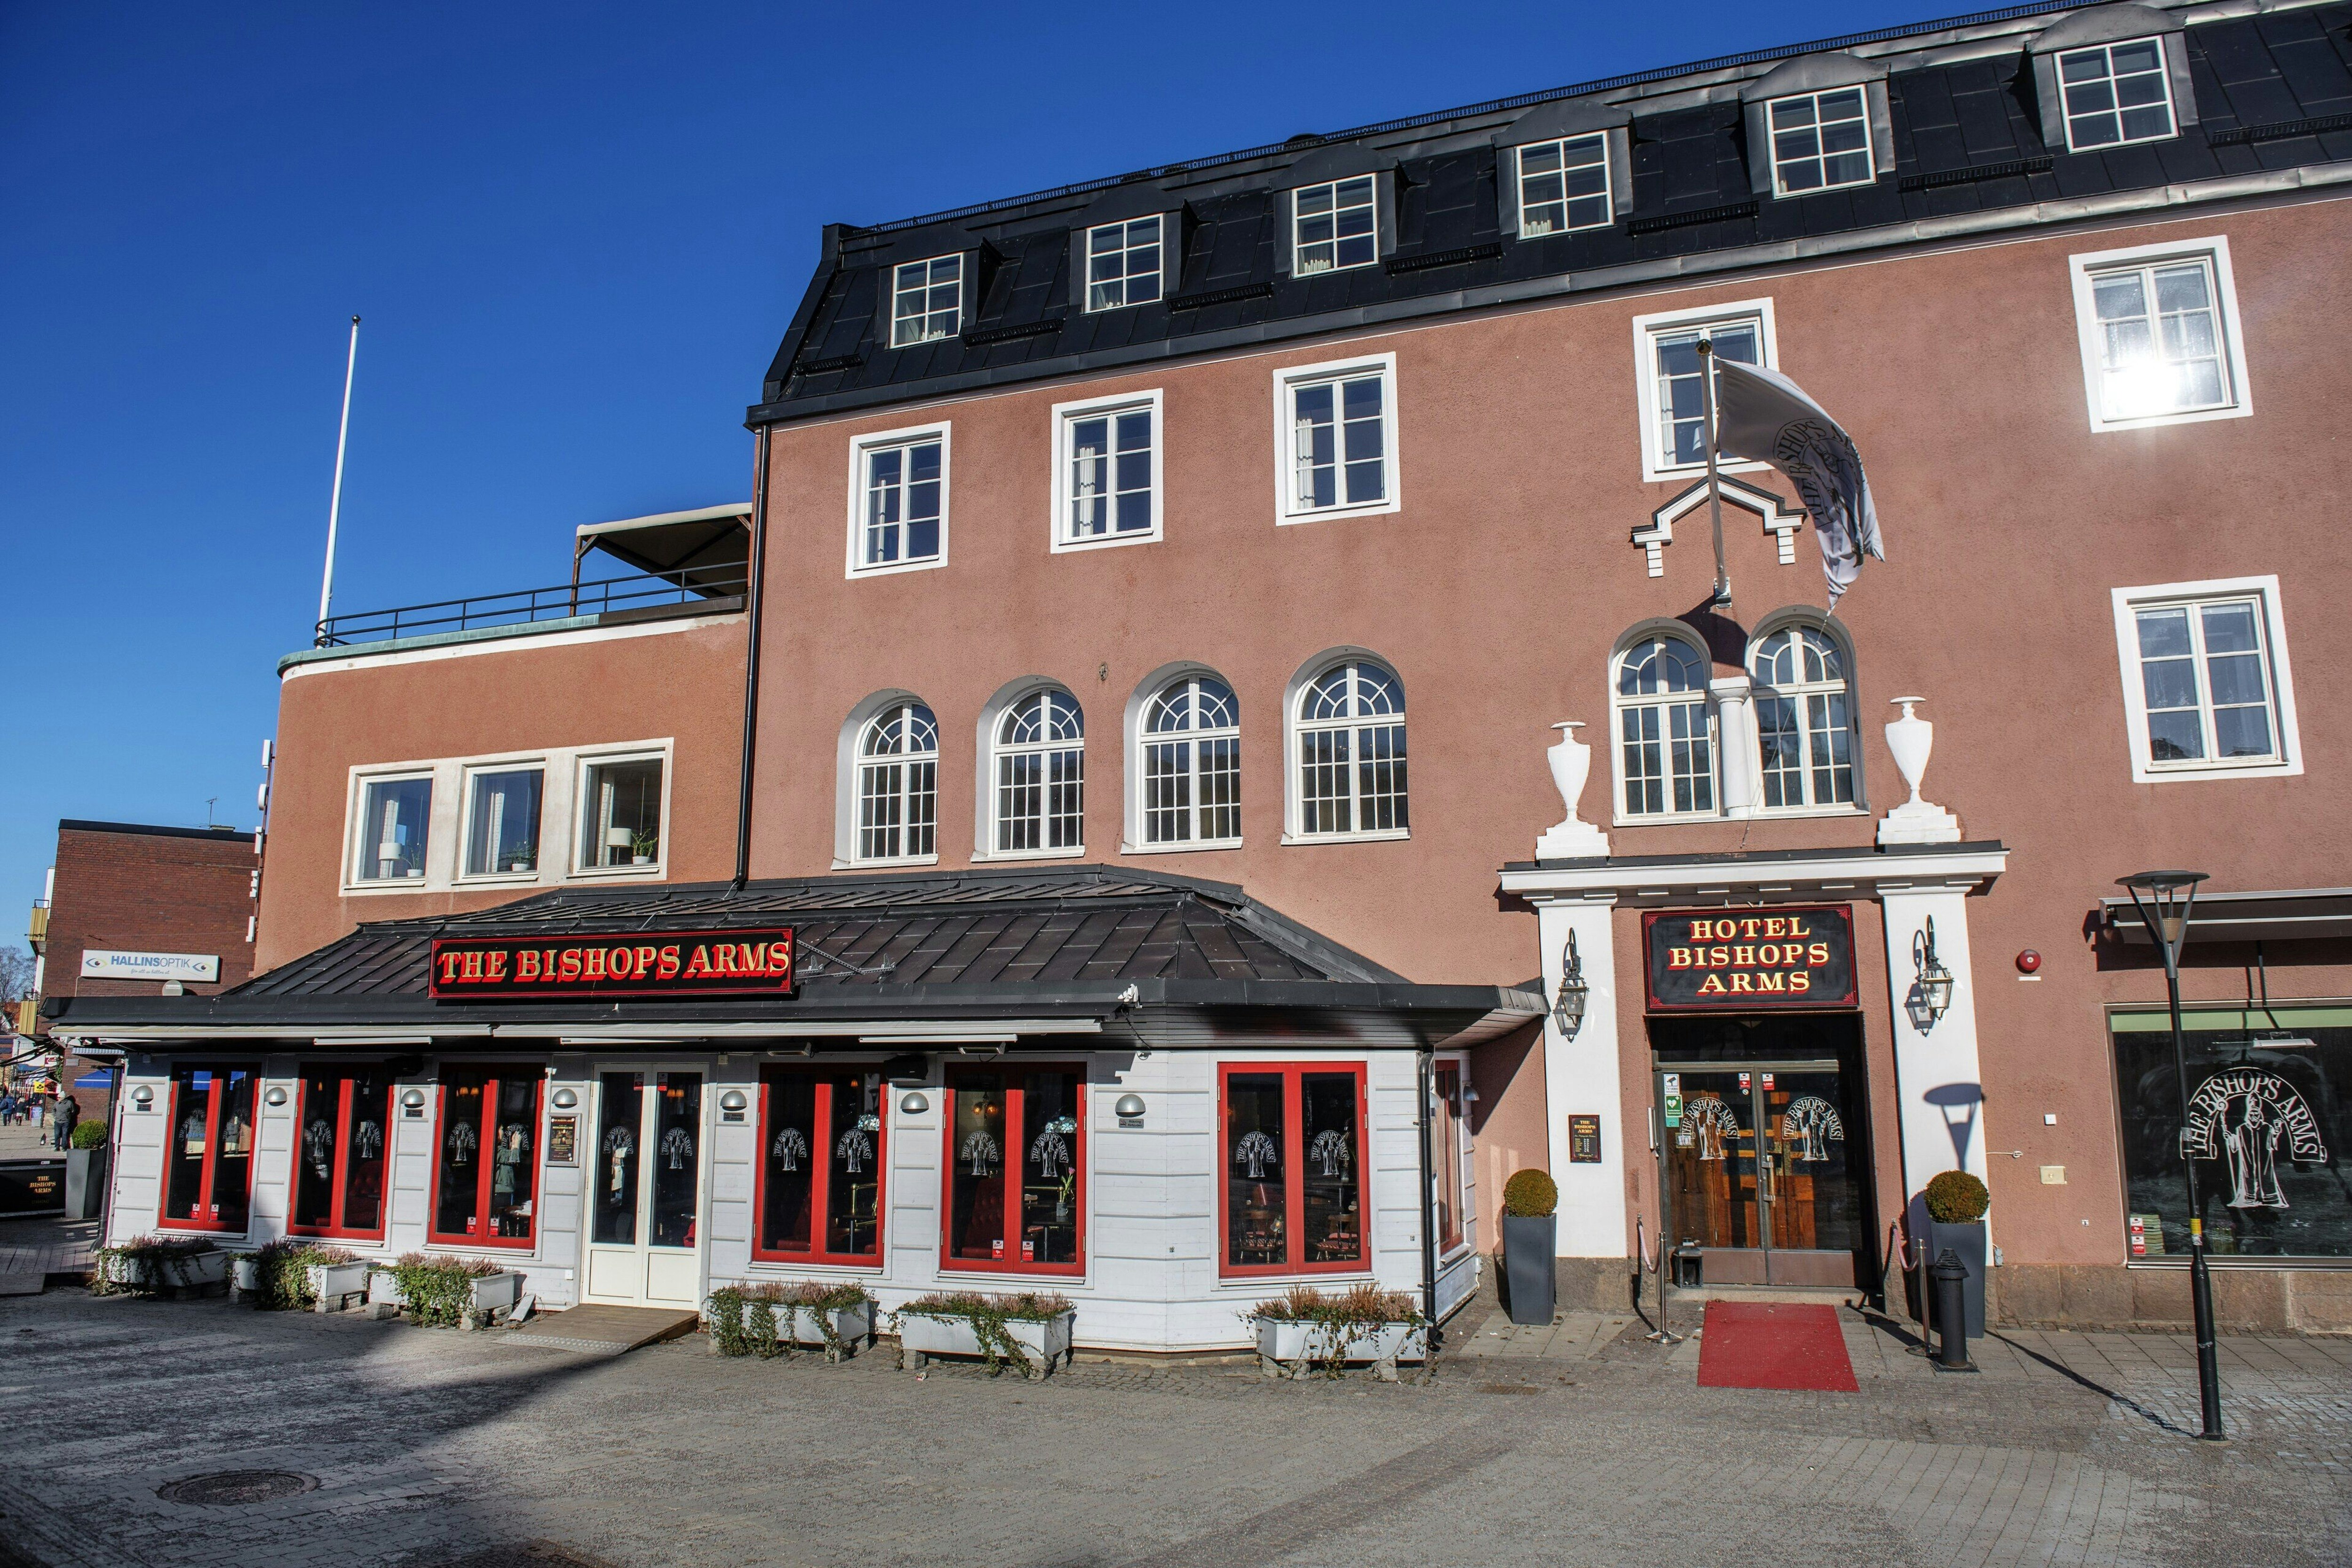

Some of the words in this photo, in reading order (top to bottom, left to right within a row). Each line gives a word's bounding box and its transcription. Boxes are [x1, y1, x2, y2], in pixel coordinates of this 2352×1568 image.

[1777, 421, 1827, 473] BSHOPS
[1689, 917, 1810, 942] HOTEL
[111, 955, 190, 968] HALLINSOPTIK
[438, 950, 507, 982] THE
[514, 945, 680, 982] BISHOPS
[683, 941, 789, 978] ARMS
[1668, 942, 1829, 970] BISHOPS
[1696, 971, 1810, 996] ARMS
[1686, 1099, 1722, 1120] BISHOPS
[1720, 1109, 1737, 1136] ARMS
[1788, 1098, 1826, 1120] BISHOPS
[2194, 1071, 2281, 1116] BISHOPS
[2275, 1096, 2318, 1154] ARMS
[665, 1129, 685, 1142] BISHOPS
[1784, 1117, 1796, 1137] THE
[1823, 1109, 1841, 1136] ARMS
[778, 1130, 799, 1143] BISHOPS
[796, 1138, 806, 1155] ARMS
[842, 1130, 863, 1144] BISHOPS
[861, 1138, 871, 1156] ARMS
[967, 1132, 989, 1146] BISHOPS
[987, 1140, 997, 1159] ARMS
[1036, 1133, 1059, 1147] BISHOPS
[1057, 1141, 1067, 1160] ARMS
[1241, 1133, 1265, 1148] BISHOPS
[1263, 1141, 1274, 1160] ARMS
[1316, 1131, 1338, 1146] BISHOPS
[1337, 1138, 1347, 1157] ARMS
